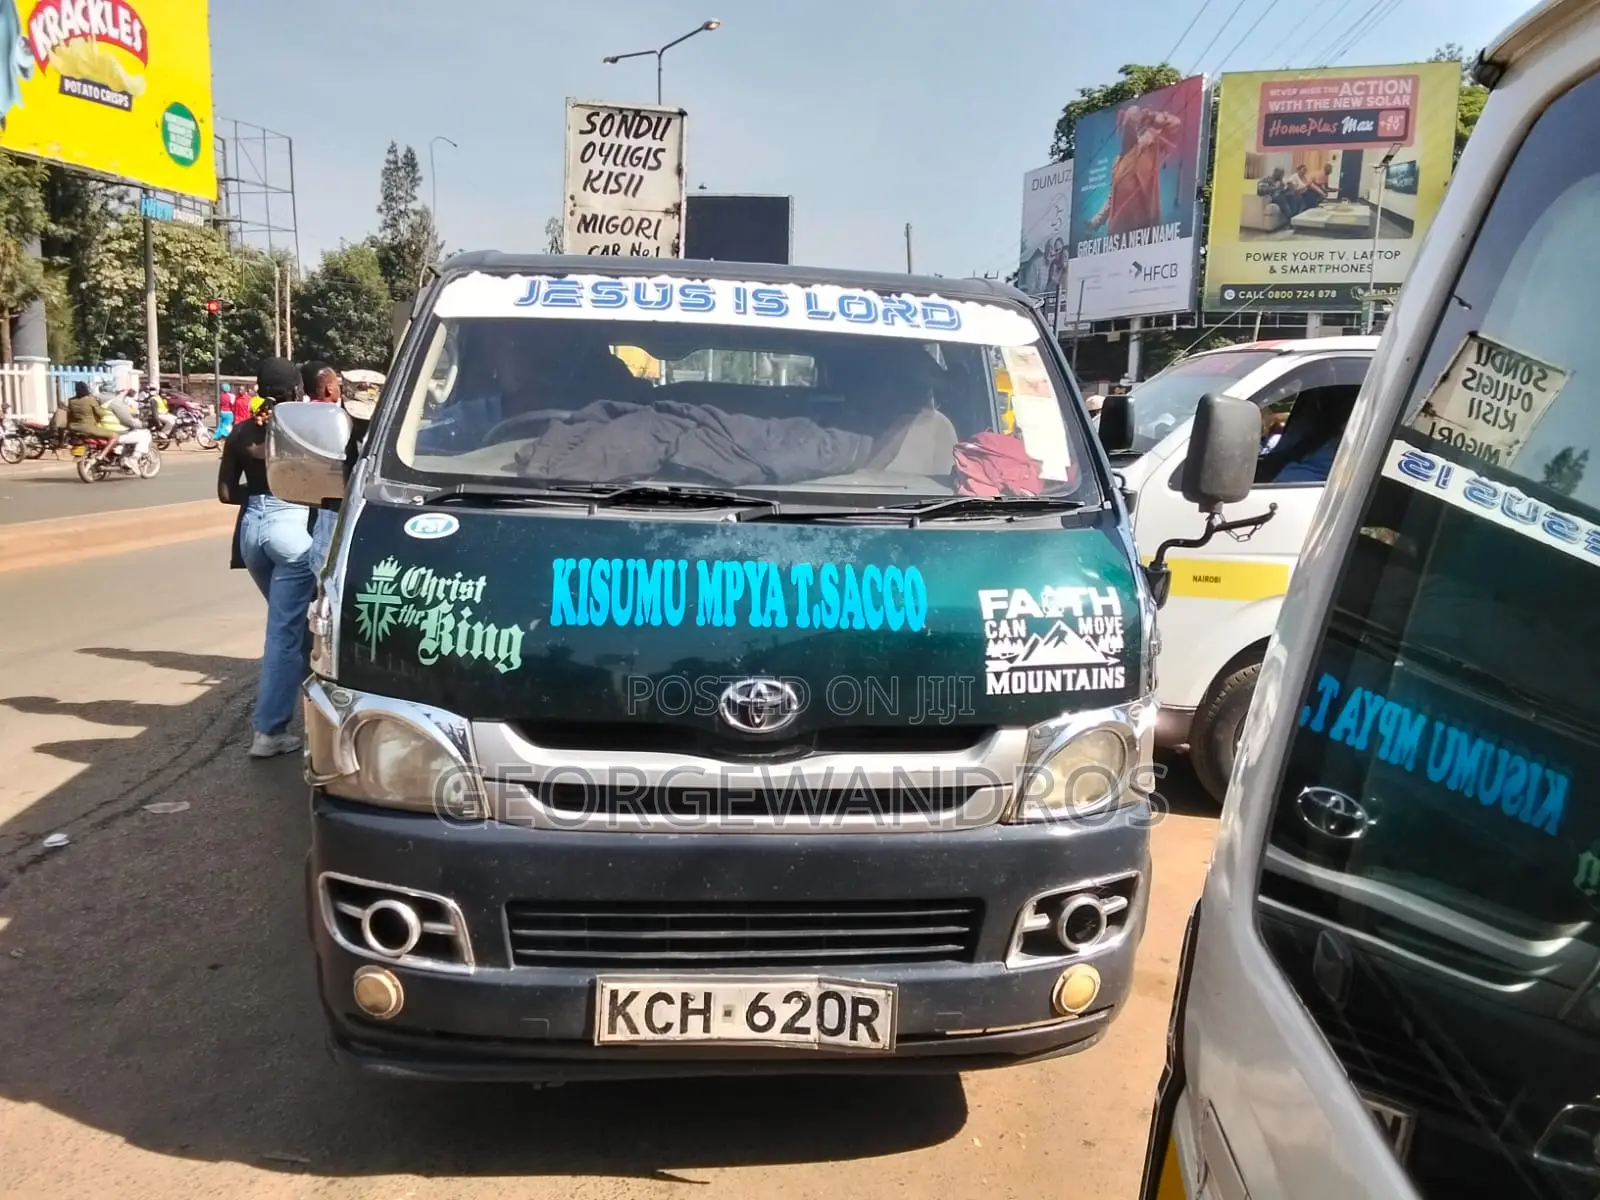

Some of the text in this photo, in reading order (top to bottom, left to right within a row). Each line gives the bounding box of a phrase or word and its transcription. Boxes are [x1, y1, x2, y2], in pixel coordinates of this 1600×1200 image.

[30, 0, 143, 61] KRACKLES
[63, 79, 129, 107] POTATO CRISPS
[1338, 79, 1413, 97] ACTION
[1269, 95, 1411, 113] WITH THE NEW SOLAR
[579, 112, 672, 141] SONDU
[1269, 116, 1374, 138] HomePlus Max
[580, 141, 666, 171] OYUGIS
[582, 169, 644, 198] KISII
[577, 213, 662, 240] MIGORI
[1078, 222, 1181, 258] GREAT HAS A NEW NAME
[1245, 252, 1287, 263] POWER
[1293, 251, 1325, 262] YOUR
[1269, 263, 1373, 275] & SMARTPHONES
[1143, 263, 1178, 282] HFCB
[514, 279, 962, 331] JESUS IS LORD
[1238, 290, 1265, 300] CALL
[400, 566, 487, 605] Christ
[1192, 574, 1222, 584] NAIROBI
[551, 558, 928, 632] KISUMU MPYA T.SACCO
[397, 603, 427, 628] the
[984, 616, 1124, 639] CAN MOVE
[417, 600, 525, 675] King
[985, 666, 1126, 695] MOUNTAINS
[607, 990, 881, 1043] KCH 620R
